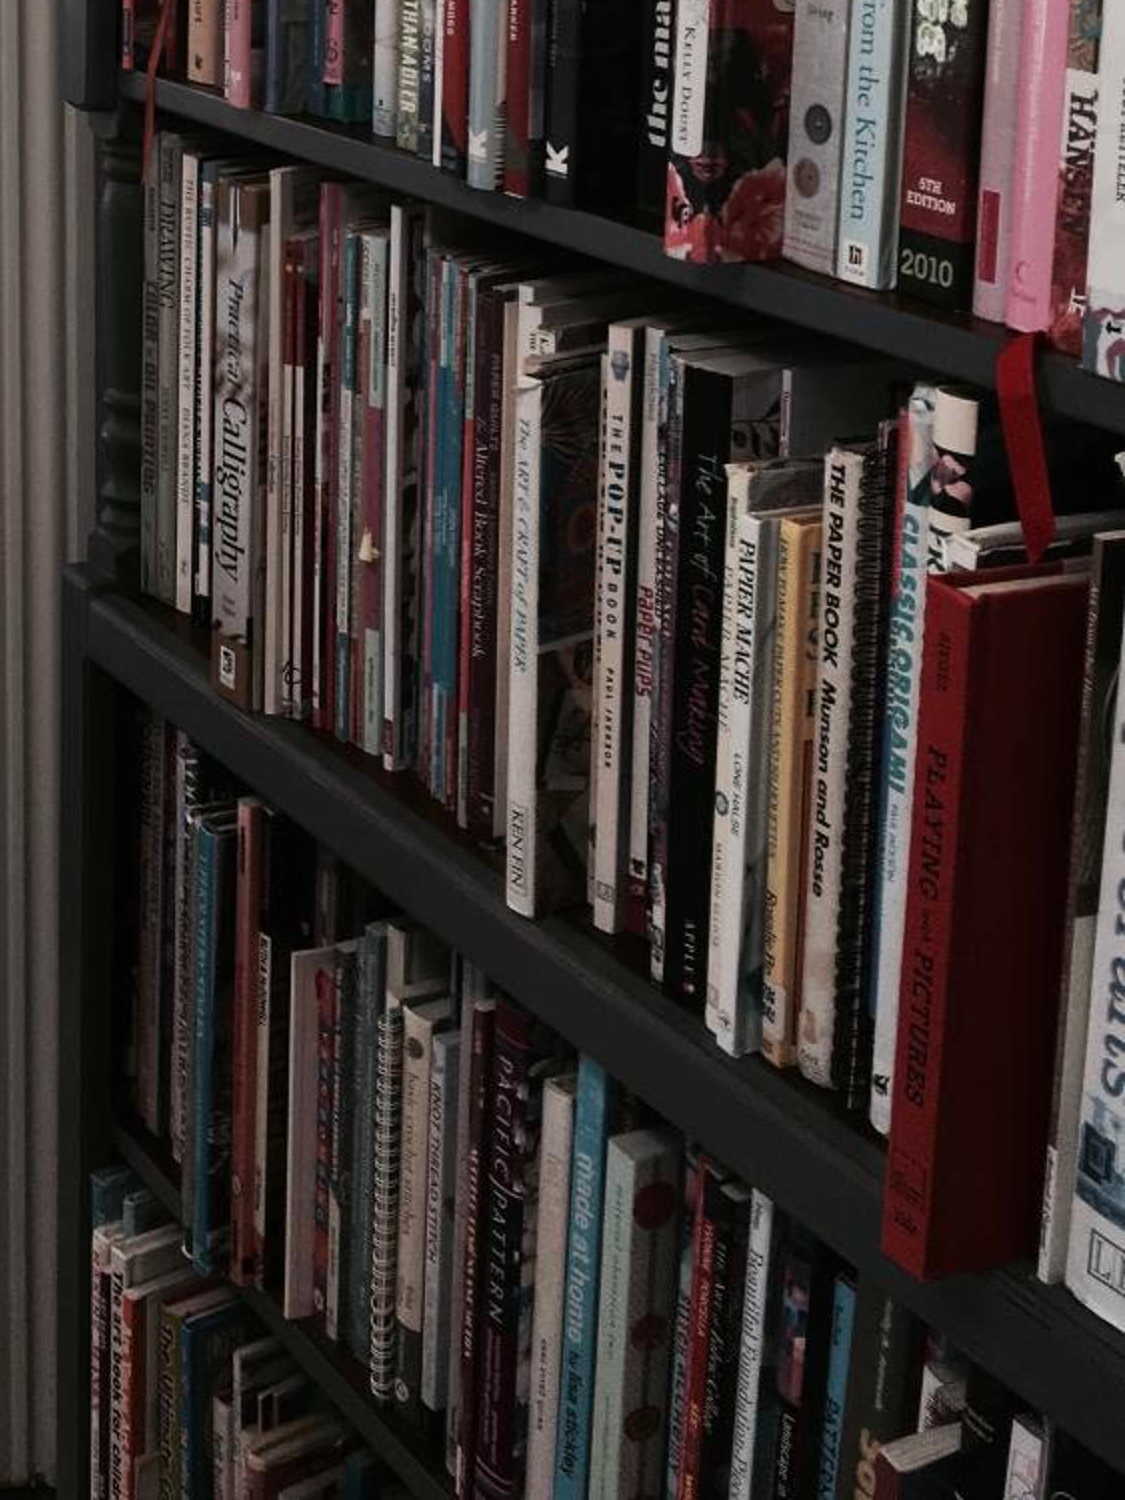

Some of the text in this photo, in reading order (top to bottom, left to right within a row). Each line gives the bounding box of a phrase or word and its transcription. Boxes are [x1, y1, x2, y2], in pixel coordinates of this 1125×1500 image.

[681, 26, 698, 79] KELLY
[401, 54, 418, 113] ADLER
[857, 65, 879, 108] the
[646, 79, 666, 148] the
[850, 117, 877, 220] Kitchen
[906, 189, 957, 217] EDITION
[900, 248, 954, 290] 2010
[610, 413, 624, 453] THE
[215, 396, 249, 583] Calligraphy
[694, 452, 719, 497] The
[606, 461, 626, 576] POP-UP
[693, 502, 716, 539] Art
[738, 539, 755, 620] PAPIER
[732, 624, 753, 705] MACHE
[812, 463, 846, 897] THE PAPER BOOK Munson and Rosse
[888, 649, 912, 793] ORIGAMI
[903, 743, 948, 1110] PLAYING PICTURES
[488, 1056, 514, 1328] PACIFIC PATTERN
[574, 1154, 593, 1229] made
[428, 1207, 437, 1264] STITCH
[573, 1235, 588, 1263] at
[113, 1271, 124, 1306] The
[568, 1268, 589, 1344] home
[113, 1320, 123, 1345] art
[112, 1350, 123, 1399] book
[112, 1409, 122, 1438] for
